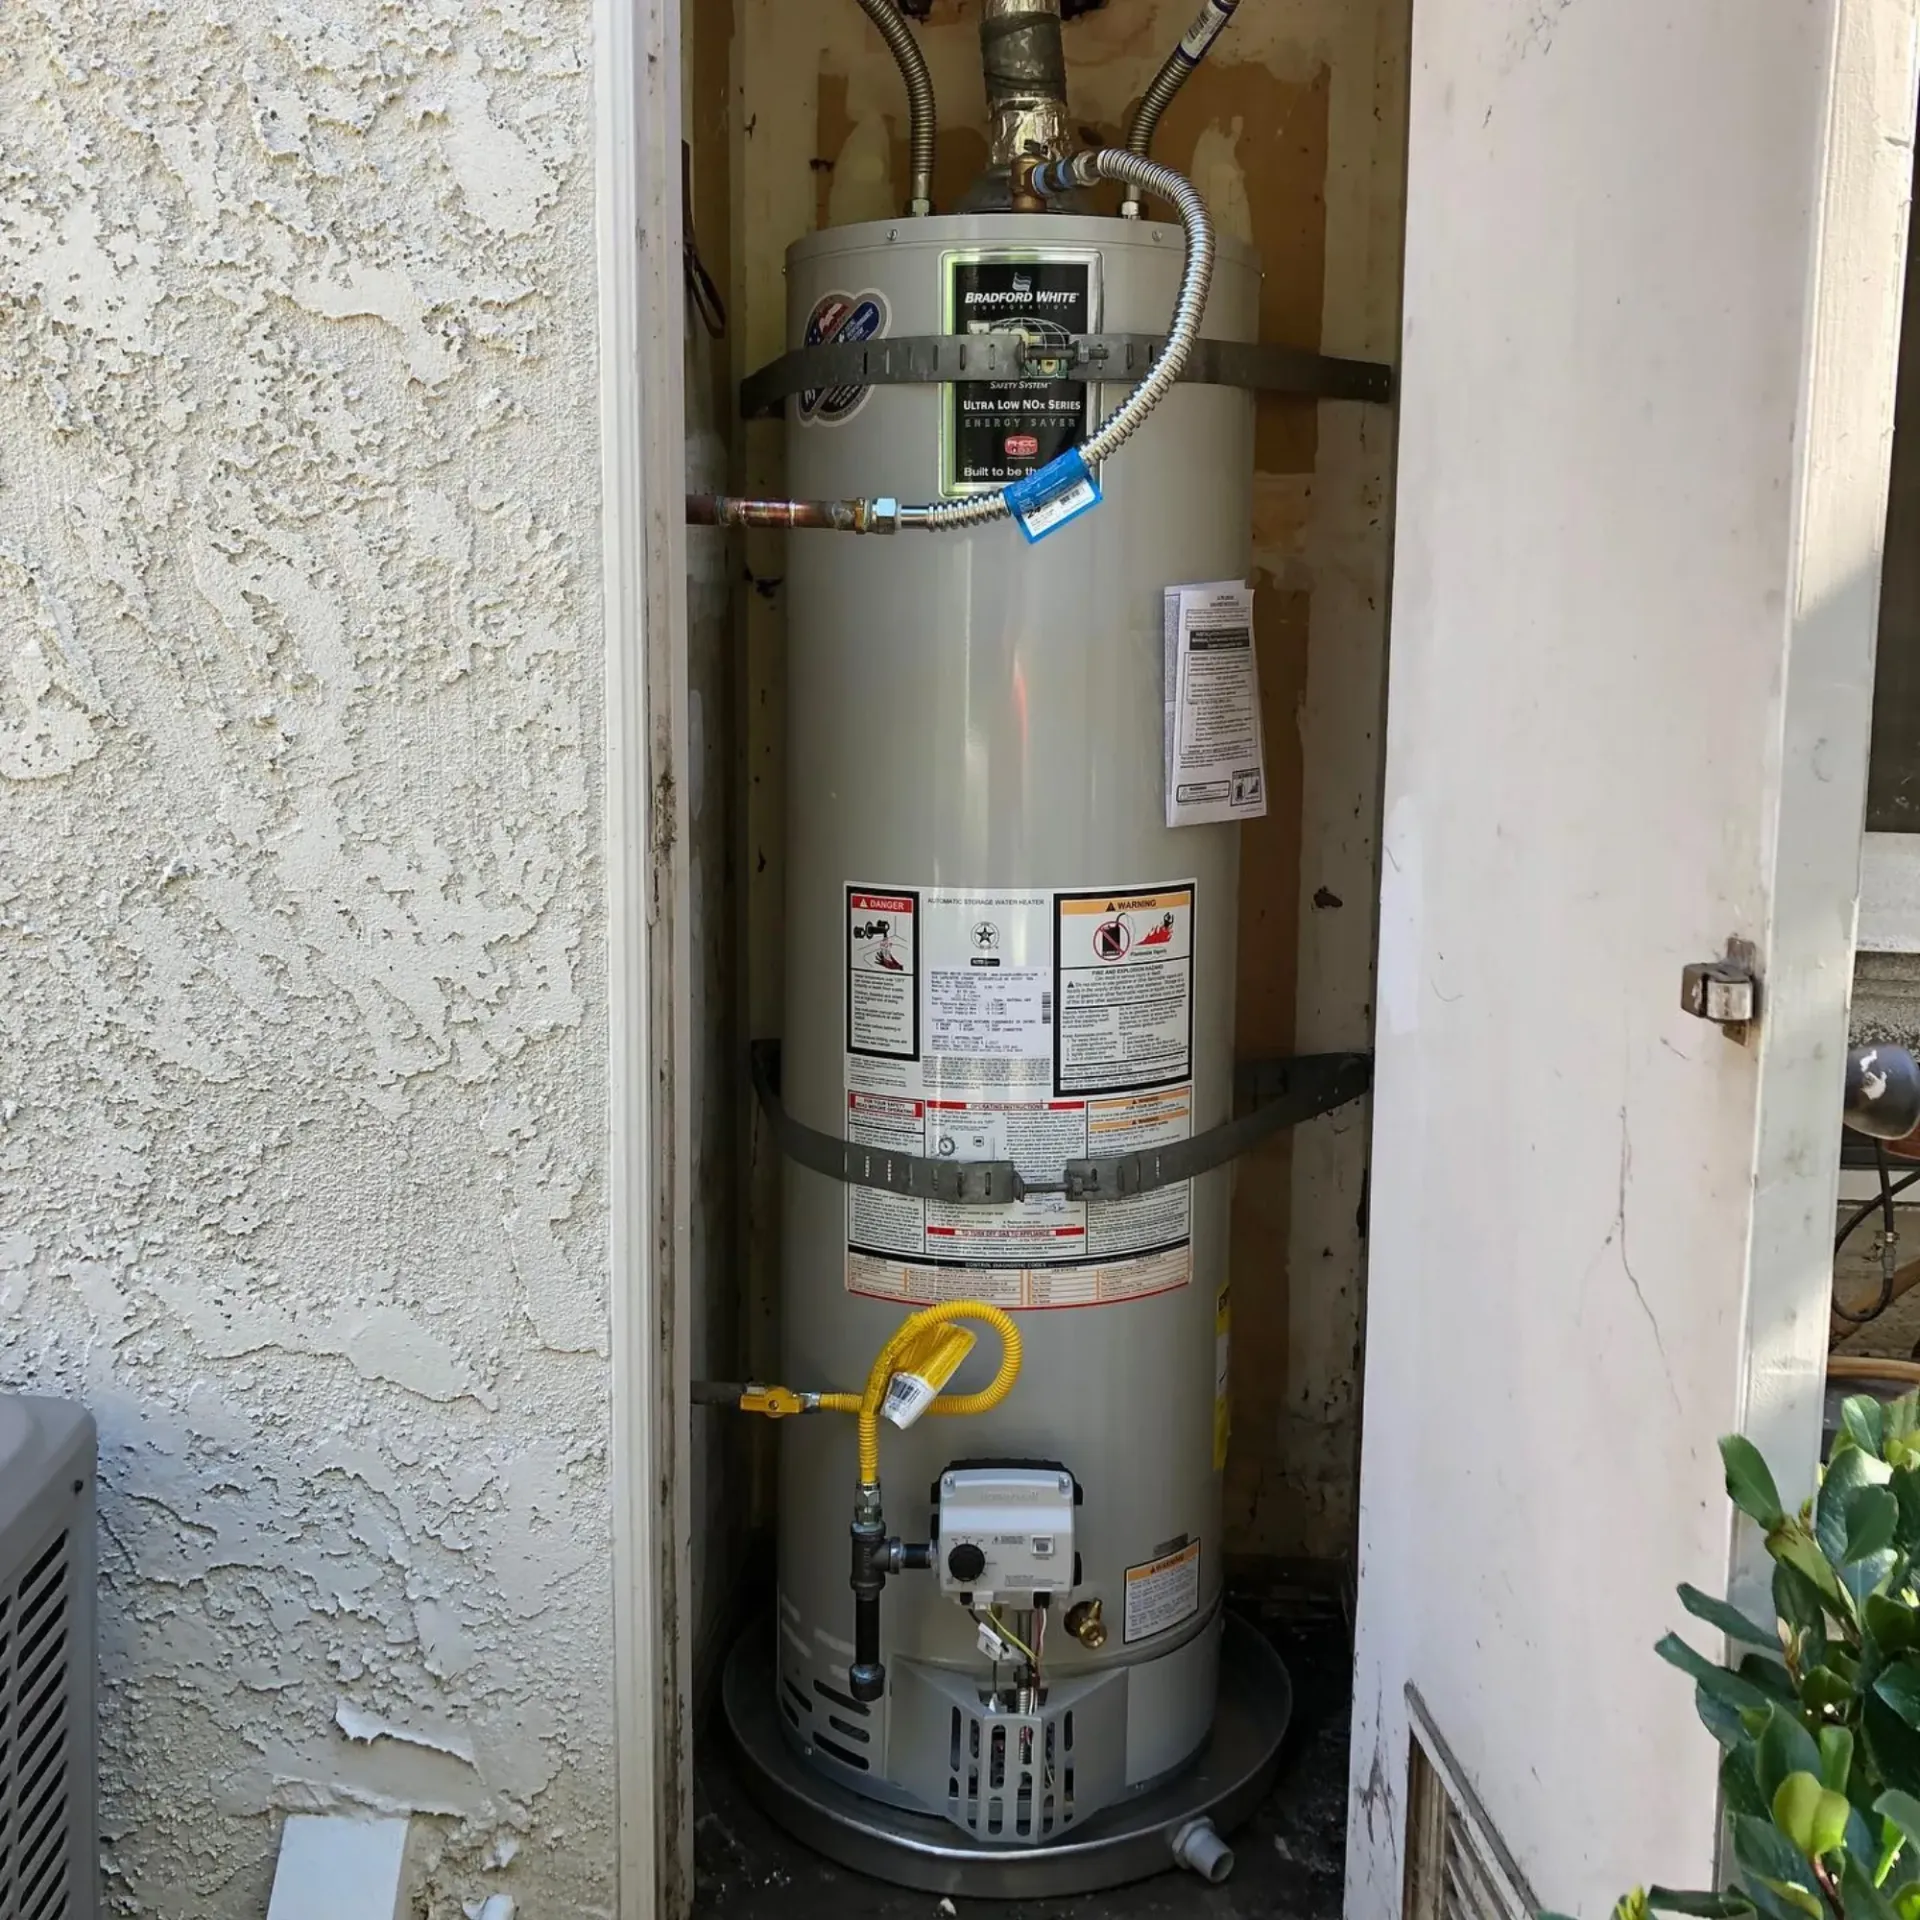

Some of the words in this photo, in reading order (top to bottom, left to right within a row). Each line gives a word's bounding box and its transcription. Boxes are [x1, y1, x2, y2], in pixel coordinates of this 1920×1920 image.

[965, 292, 1032, 303] BRADFORD
[1036, 291, 1077, 303] WHITE
[990, 381, 1018, 390] SAFETY
[963, 400, 995, 411] ULTRA
[997, 400, 1020, 411] LOW
[1047, 400, 1081, 411] SERIES
[965, 418, 1021, 428] ENERGY
[1031, 418, 1076, 428] SAVER
[963, 467, 989, 477] Built
[992, 467, 1004, 477] to
[1006, 467, 1022, 477] be
[1025, 467, 1038, 478] th
[869, 900, 905, 911] DANGER
[928, 897, 962, 906] AUTOMATIC
[964, 898, 993, 906] STORAGE
[1117, 899, 1157, 910] WARNING
